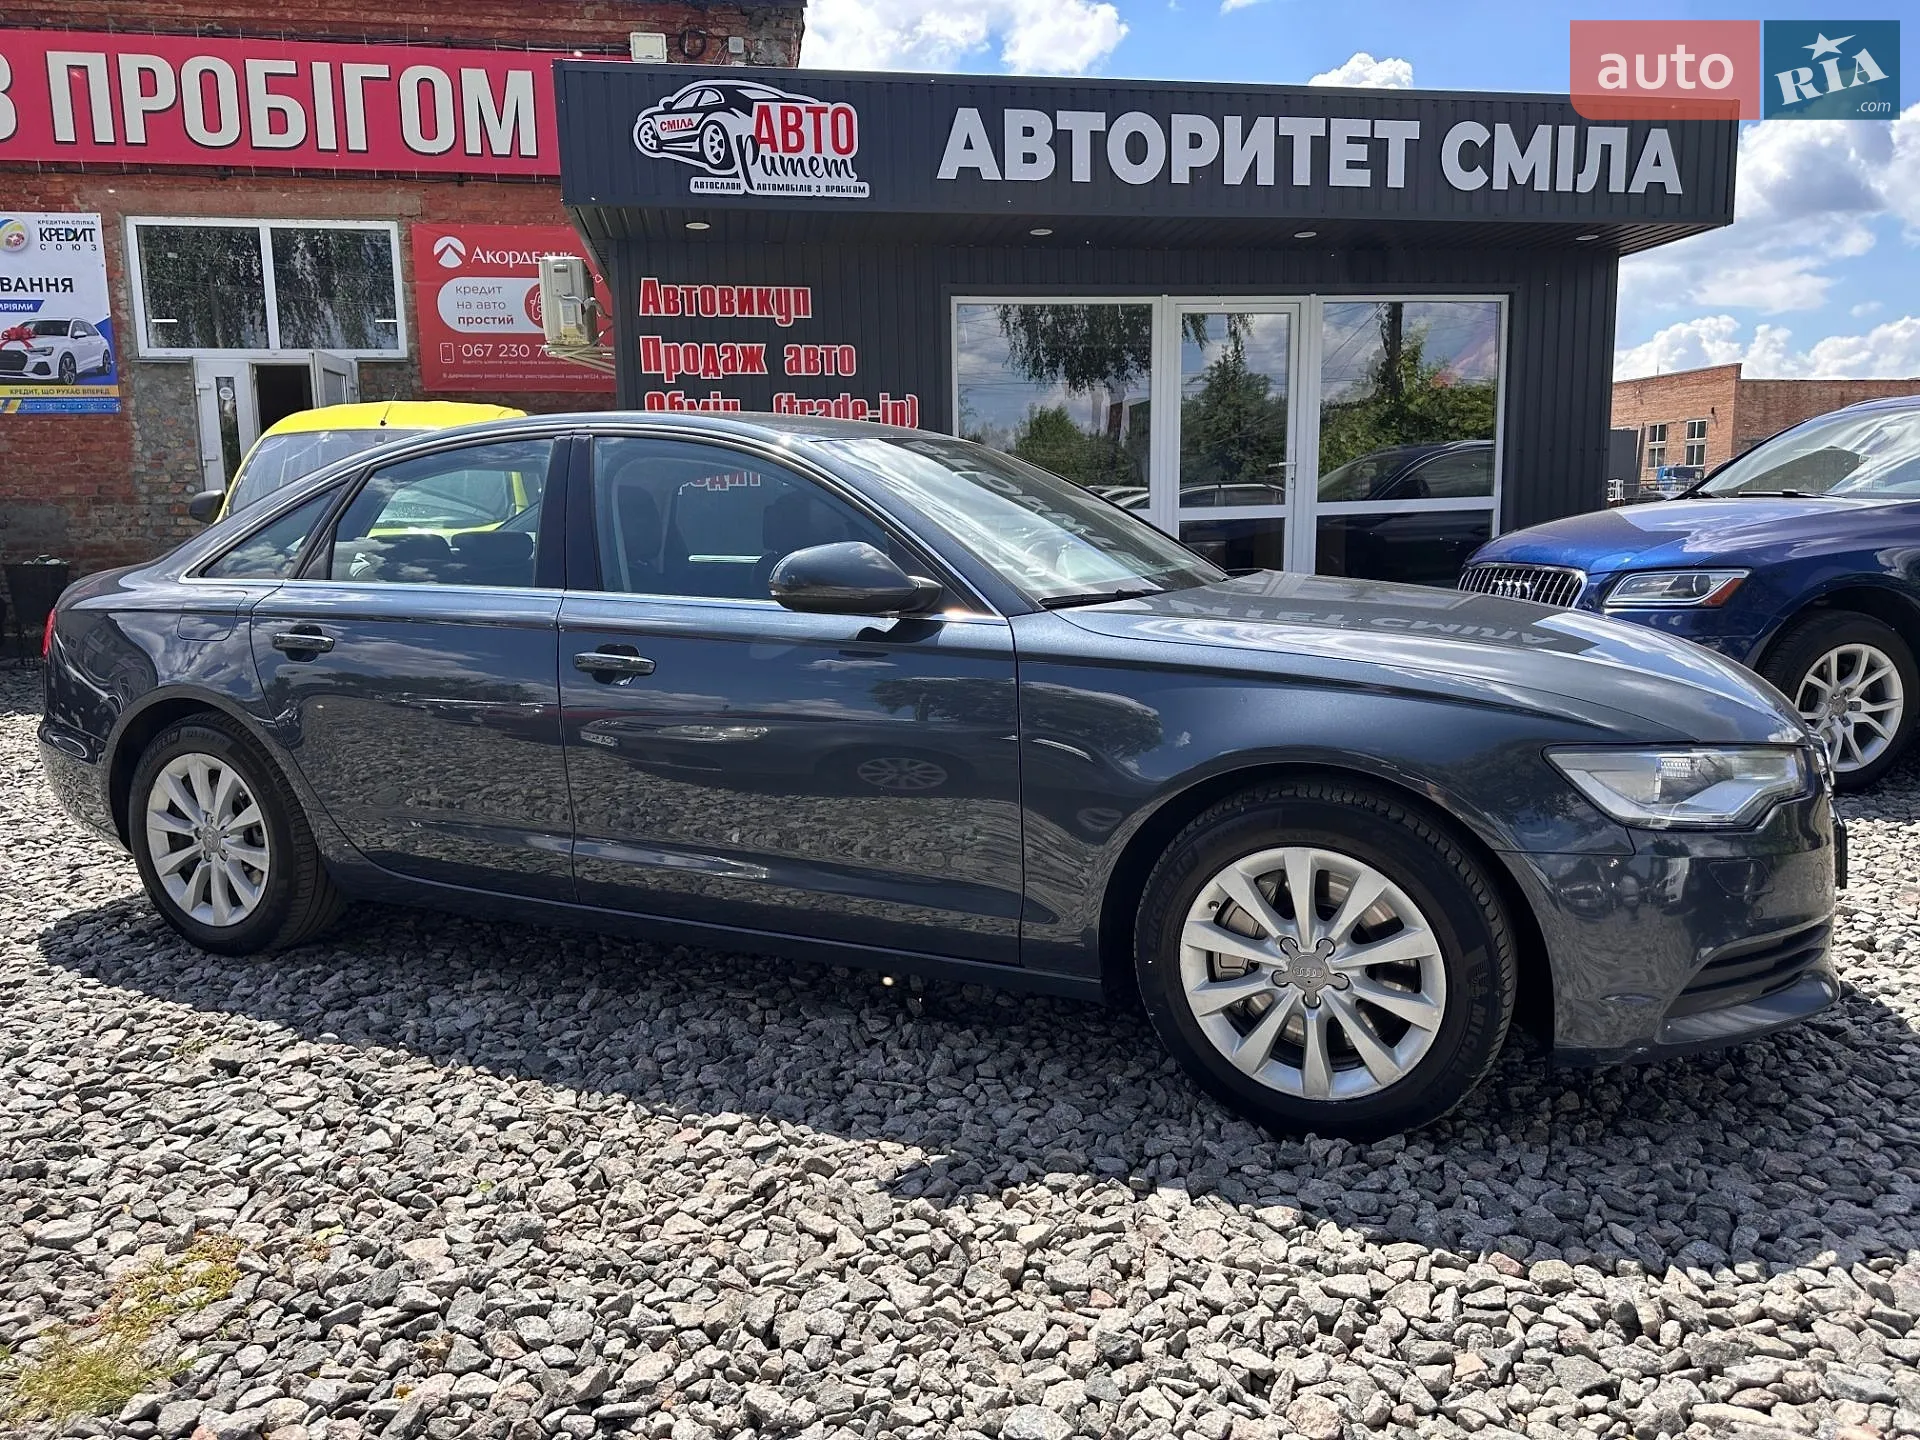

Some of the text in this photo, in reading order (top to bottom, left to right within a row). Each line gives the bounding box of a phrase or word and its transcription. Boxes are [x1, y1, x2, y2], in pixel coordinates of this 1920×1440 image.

[46, 50, 538, 157] ПРОБІГОМ
[659, 117, 694, 132] СМІЛА
[755, 104, 855, 155] АВТО
[936, 107, 1683, 195] АВТОРИТЕТ СМІЛА
[694, 180, 742, 190] АВТОСАЛОН
[756, 182, 812, 193] АВТОМОБІЛІВ
[825, 184, 866, 194] ПРОБІГОМ
[39, 228, 96, 242] КРЕДИТ
[0, 277, 74, 293] ВАННЯ
[455, 285, 503, 299] кредит
[476, 302, 506, 310] авто
[639, 277, 812, 327] Автовикуп
[457, 314, 514, 329] простий
[462, 344, 493, 358] 067
[498, 344, 530, 358] 230
[639, 335, 856, 384] Продаж авто
